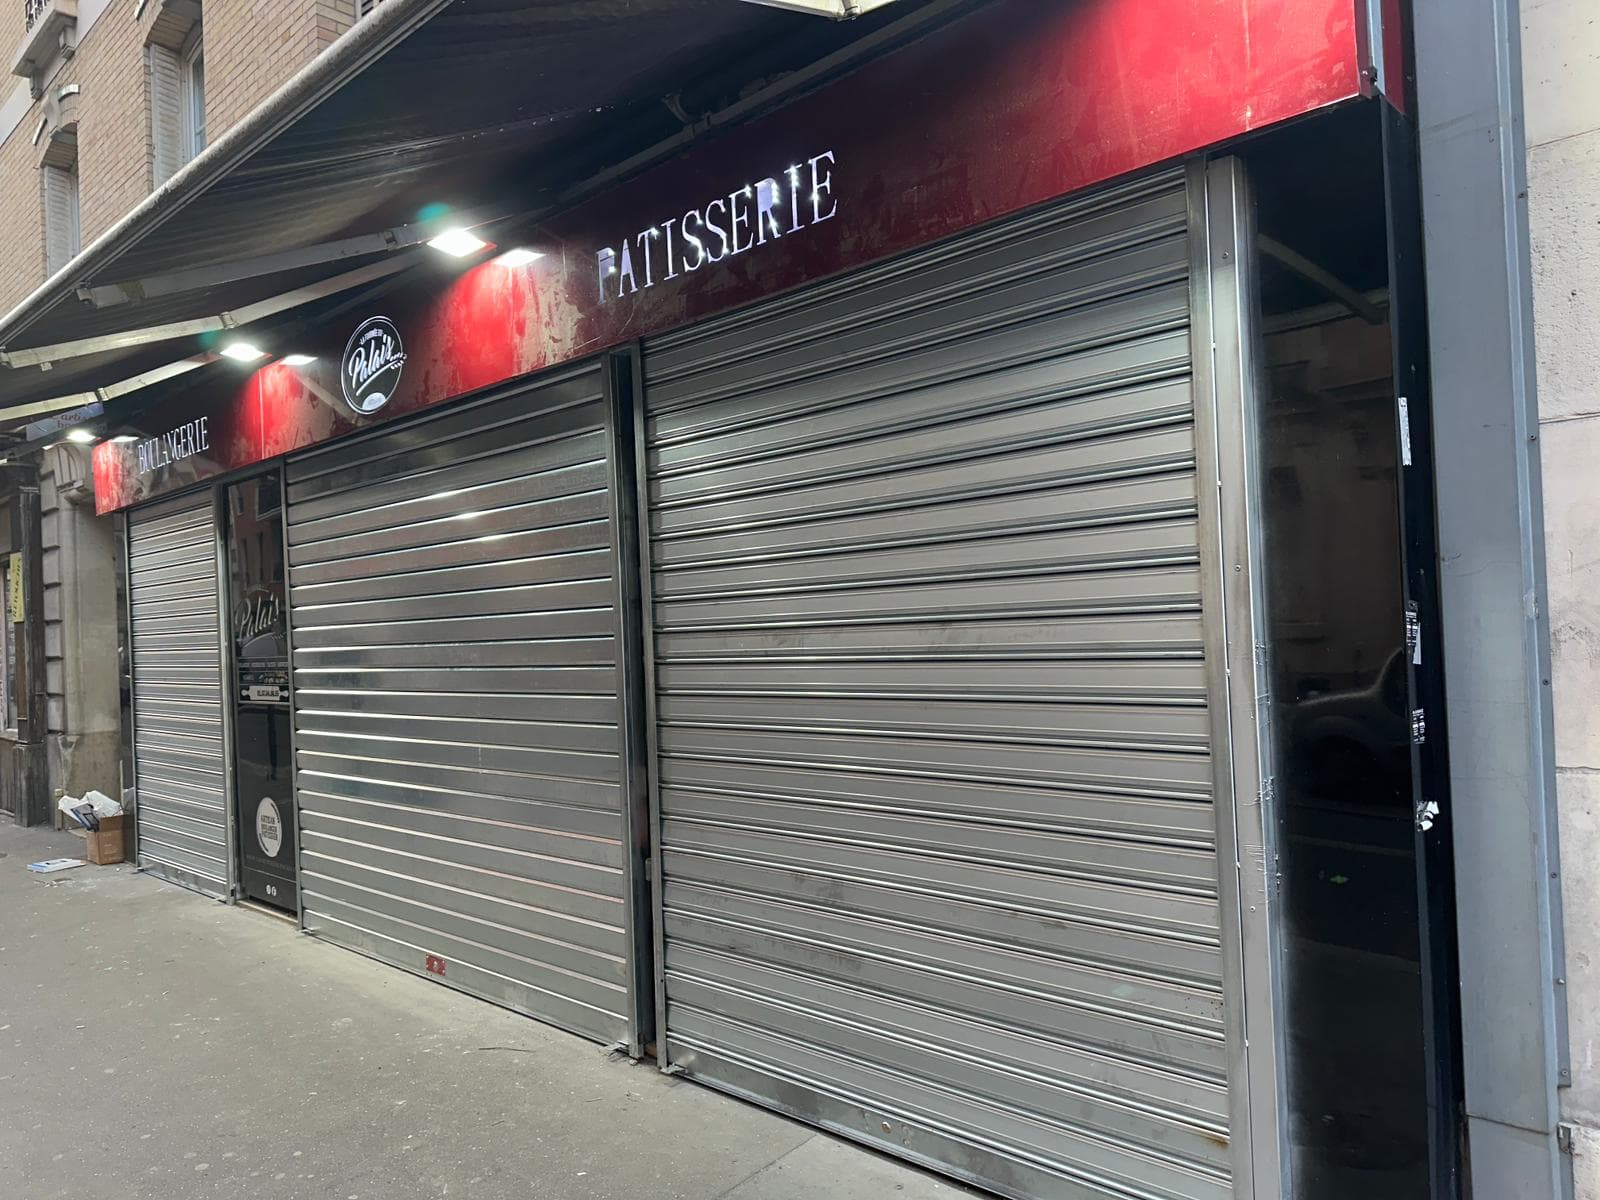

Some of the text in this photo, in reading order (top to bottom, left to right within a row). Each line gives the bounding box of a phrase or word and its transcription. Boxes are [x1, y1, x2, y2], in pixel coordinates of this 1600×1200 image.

[596, 150, 838, 305] PATISSERIE
[348, 335, 395, 389] Palais
[138, 416, 209, 475] BOULANGERIE
